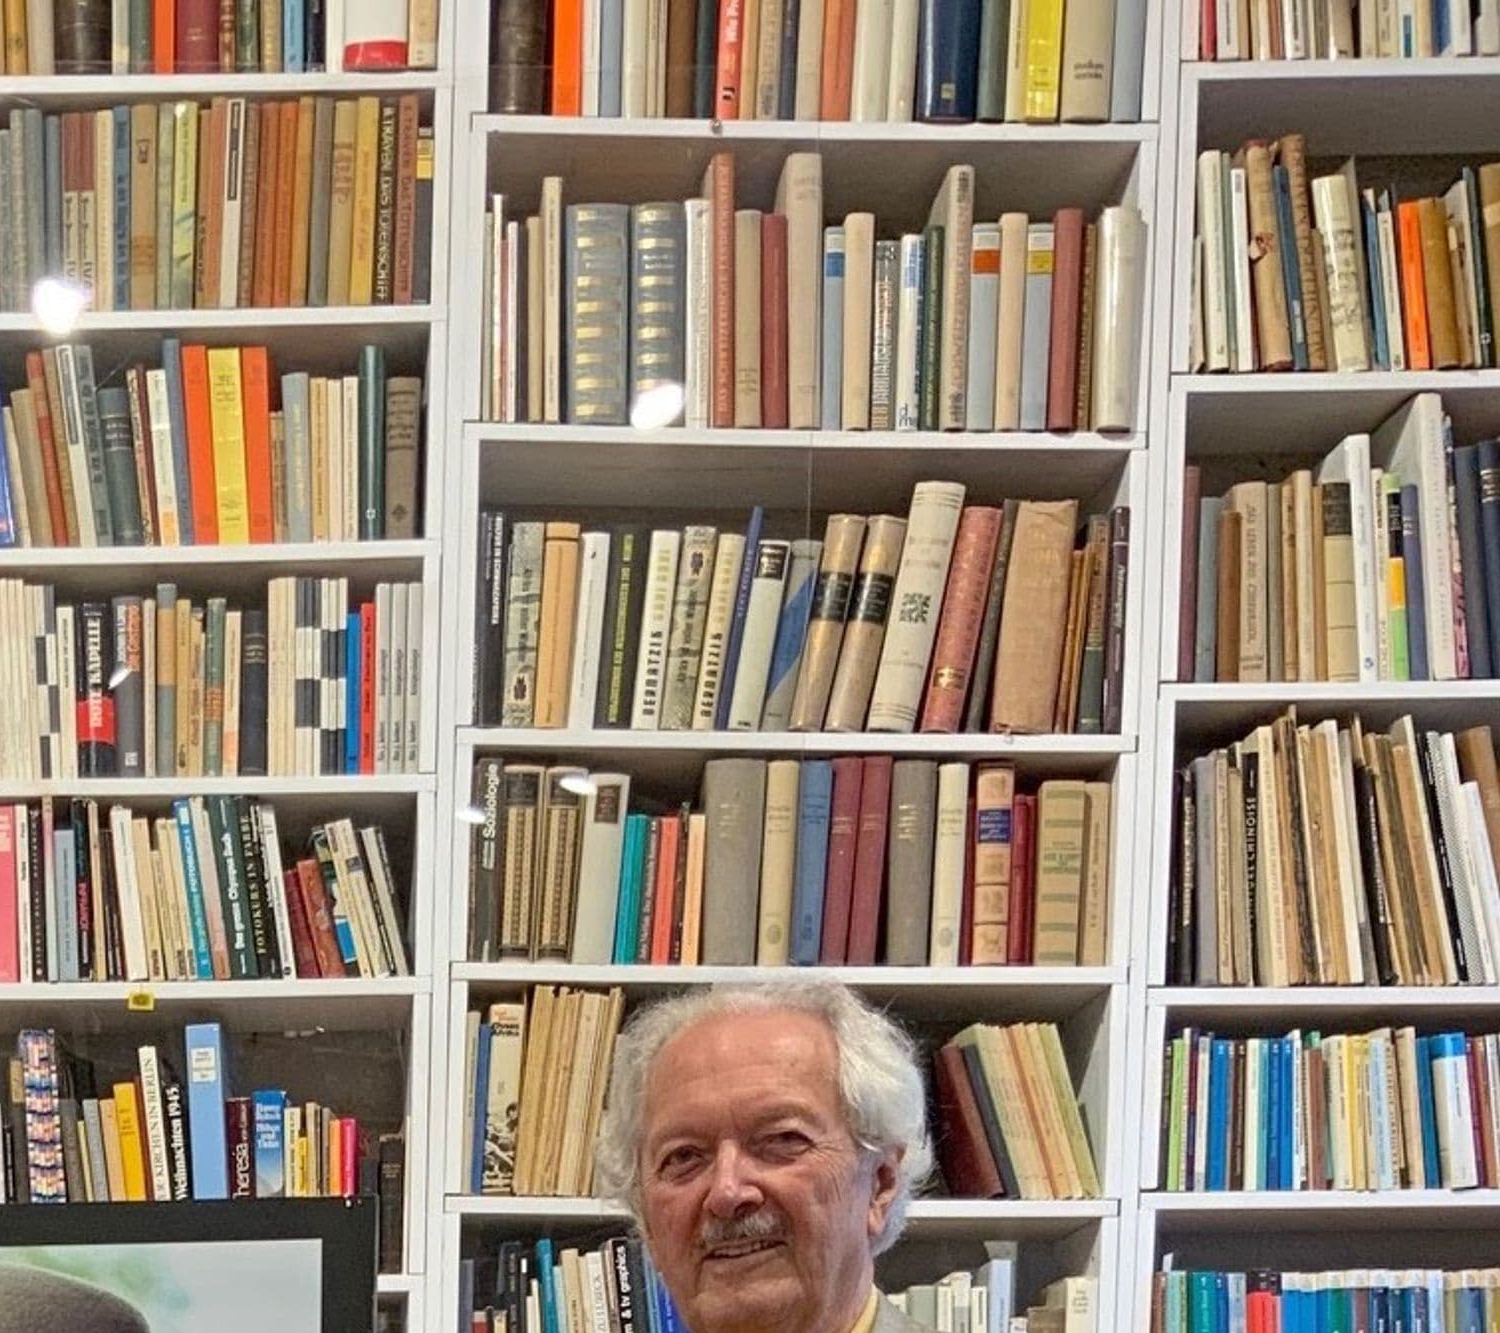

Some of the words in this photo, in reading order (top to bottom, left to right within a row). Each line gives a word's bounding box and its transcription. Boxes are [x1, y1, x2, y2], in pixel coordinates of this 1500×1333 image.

[377, 176, 393, 205] DAS
[375, 208, 392, 301] TOTENSCHIFF
[86, 617, 102, 684] KAPELLE
[641, 629, 664, 716] BERNATZIK
[700, 632, 722, 717] BERNATZIK
[88, 687, 103, 728] ROTE
[482, 763, 500, 839] Soziologie
[220, 832, 234, 856] Buch
[239, 814, 255, 856] FARBE
[1244, 796, 1257, 861] CHINOISE
[224, 857, 242, 899] Olympus
[231, 932, 245, 949] Das
[248, 883, 267, 954] FOTOKURS
[143, 1058, 157, 1103] BERLIN
[167, 1087, 183, 1116] 1945
[148, 1105, 160, 1120] IN
[150, 1121, 165, 1177] KIRCHEN
[170, 1119, 189, 1200] Weihnachten
[232, 1143, 251, 1200] heresia
[615, 1245, 633, 1293] graphics
